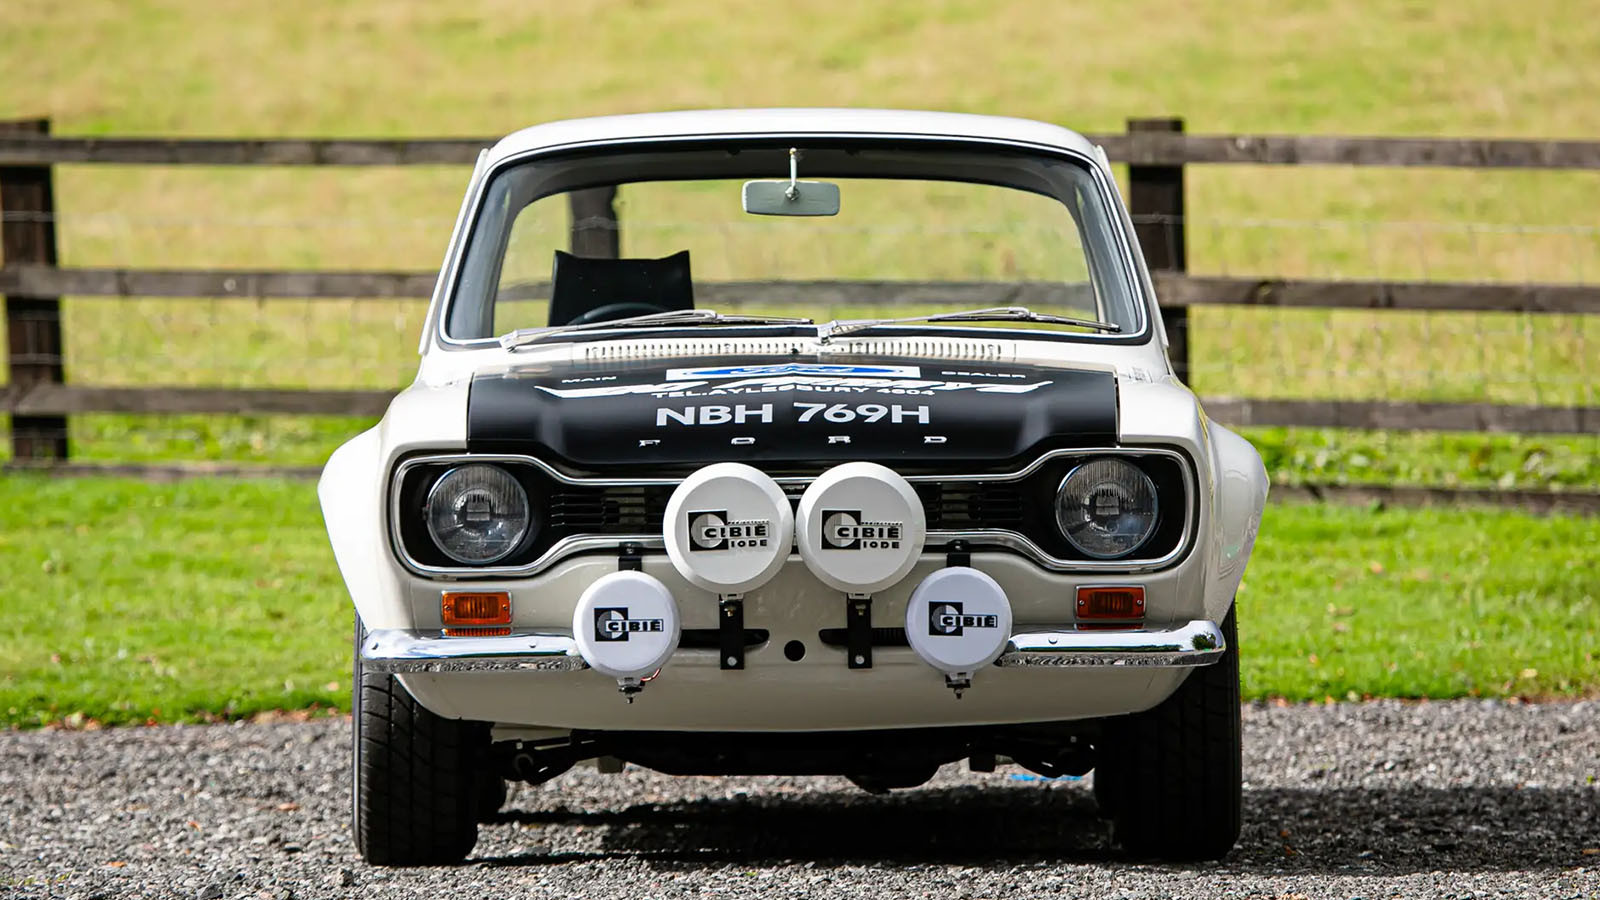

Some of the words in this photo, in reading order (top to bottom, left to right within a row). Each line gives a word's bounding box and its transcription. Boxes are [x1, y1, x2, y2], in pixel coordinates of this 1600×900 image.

[561, 376, 617, 384] MAIN
[656, 403, 774, 427] NBH
[793, 402, 930, 425] 769H
[638, 436, 948, 447] FORD
[730, 539, 768, 548] IODE
[863, 541, 900, 549] IODE
